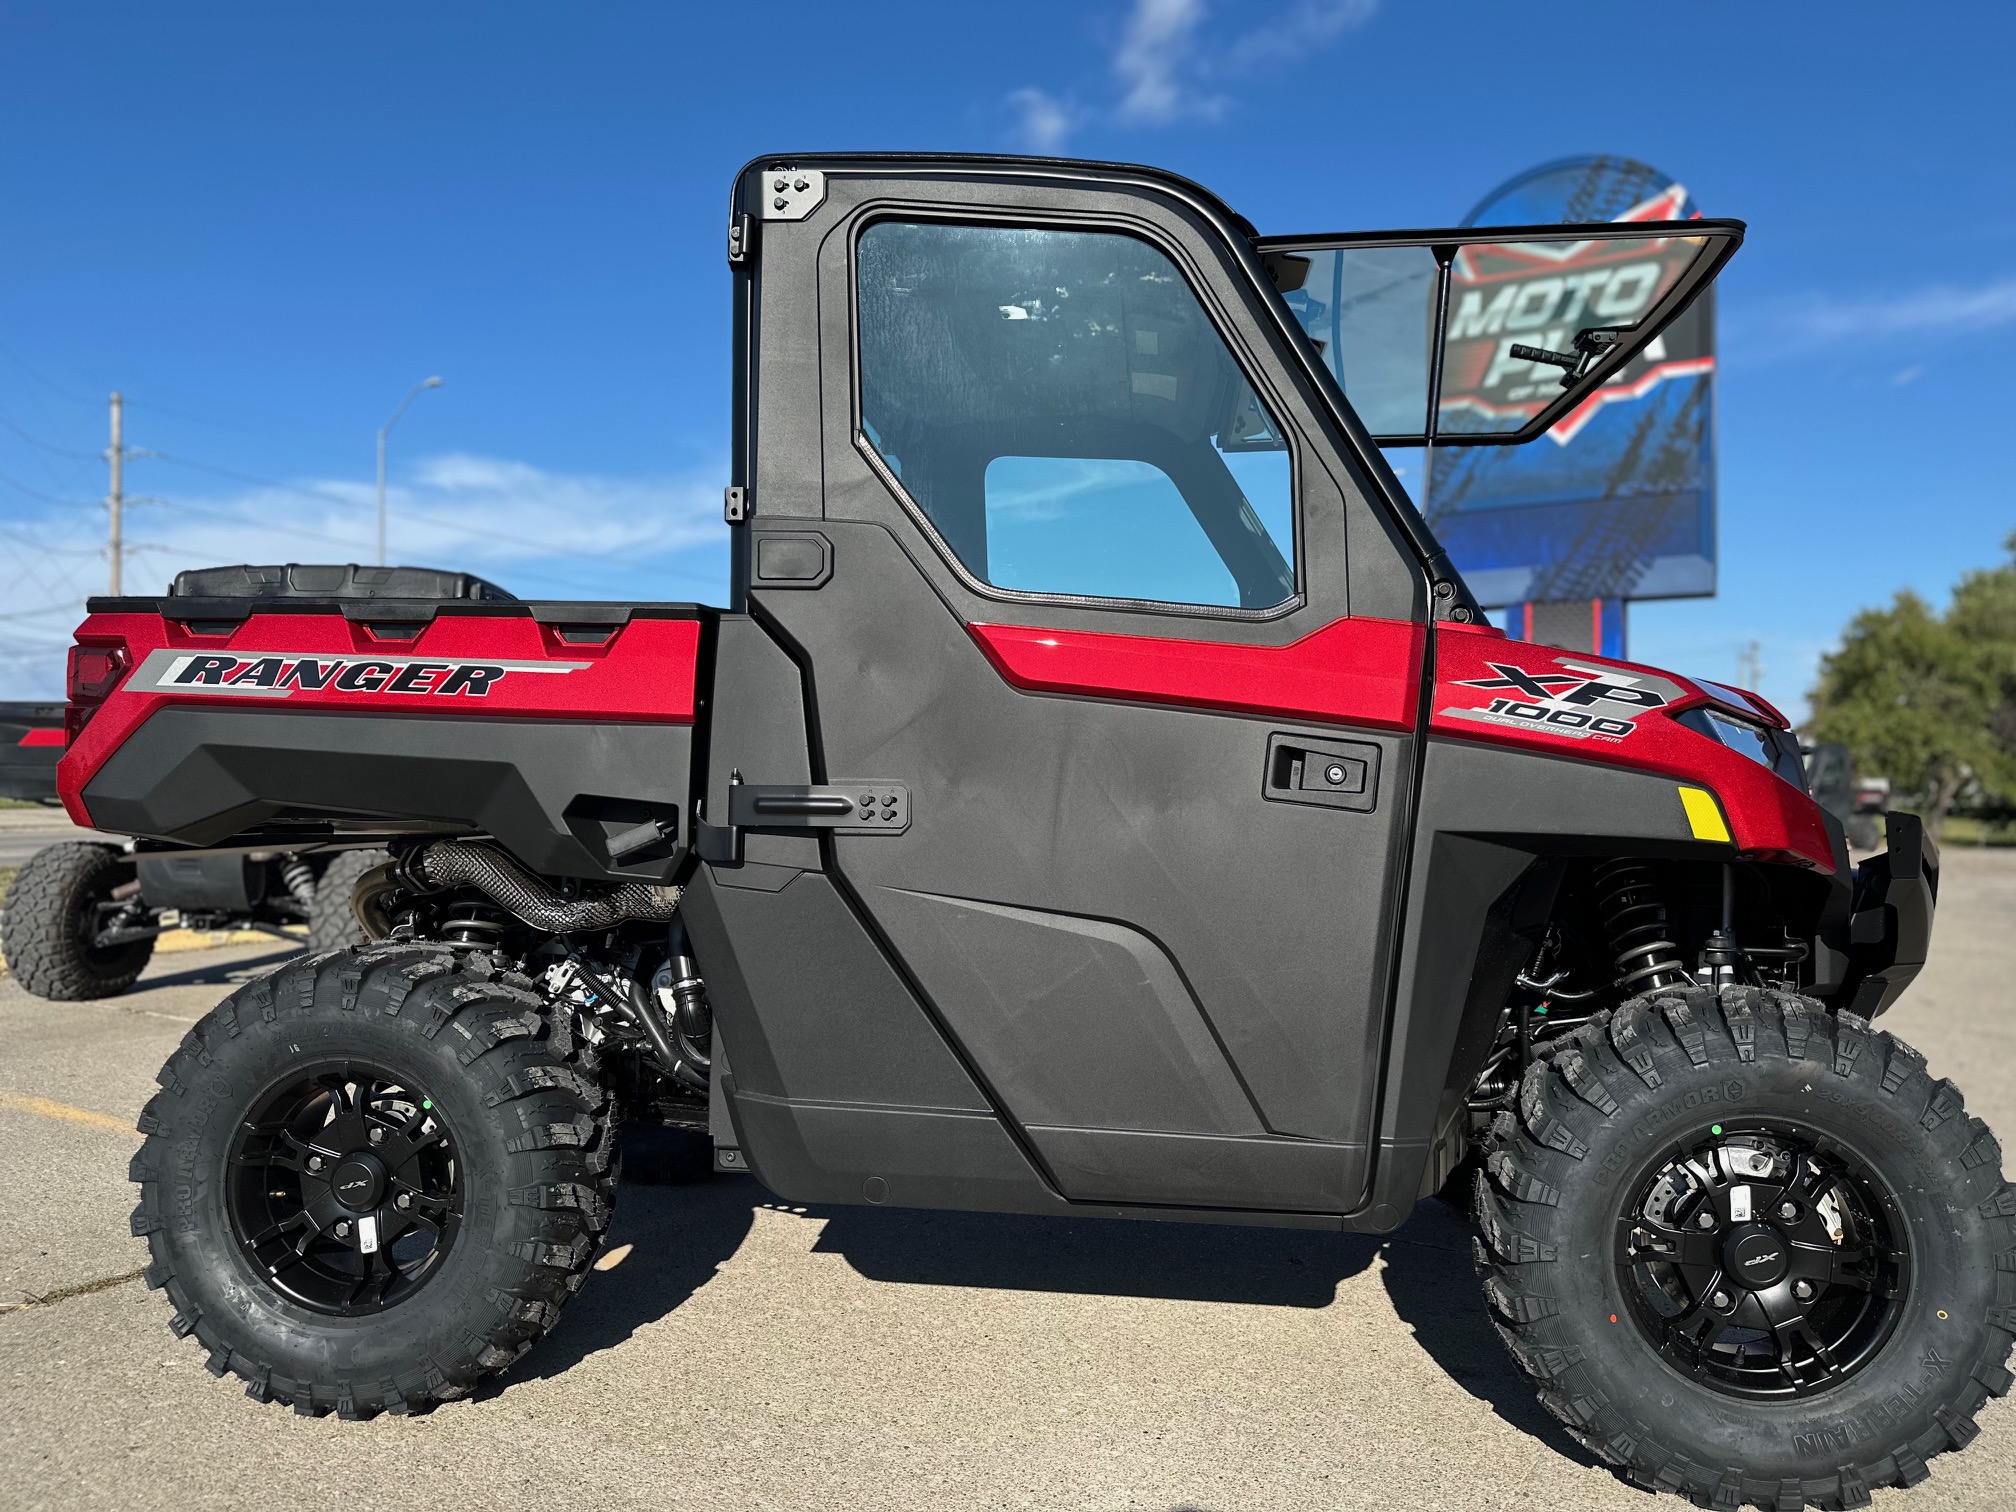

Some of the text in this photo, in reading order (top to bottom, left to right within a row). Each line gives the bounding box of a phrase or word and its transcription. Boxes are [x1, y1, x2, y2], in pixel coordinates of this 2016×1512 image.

[1448, 262, 1660, 340] MOTO
[173, 654, 506, 697] RANGER
[1449, 661, 1668, 710] XP
[1482, 715, 1623, 744] DUAL OVERHEAD CAM
[1488, 697, 1637, 737] 1000
[175, 1098, 218, 1233] PRO ARMOR
[1593, 1086, 1719, 1186] PRO ARMOR
[442, 1157, 499, 1317] X-TERRAIN
[1794, 1347, 1953, 1459] X-TERRAIN
